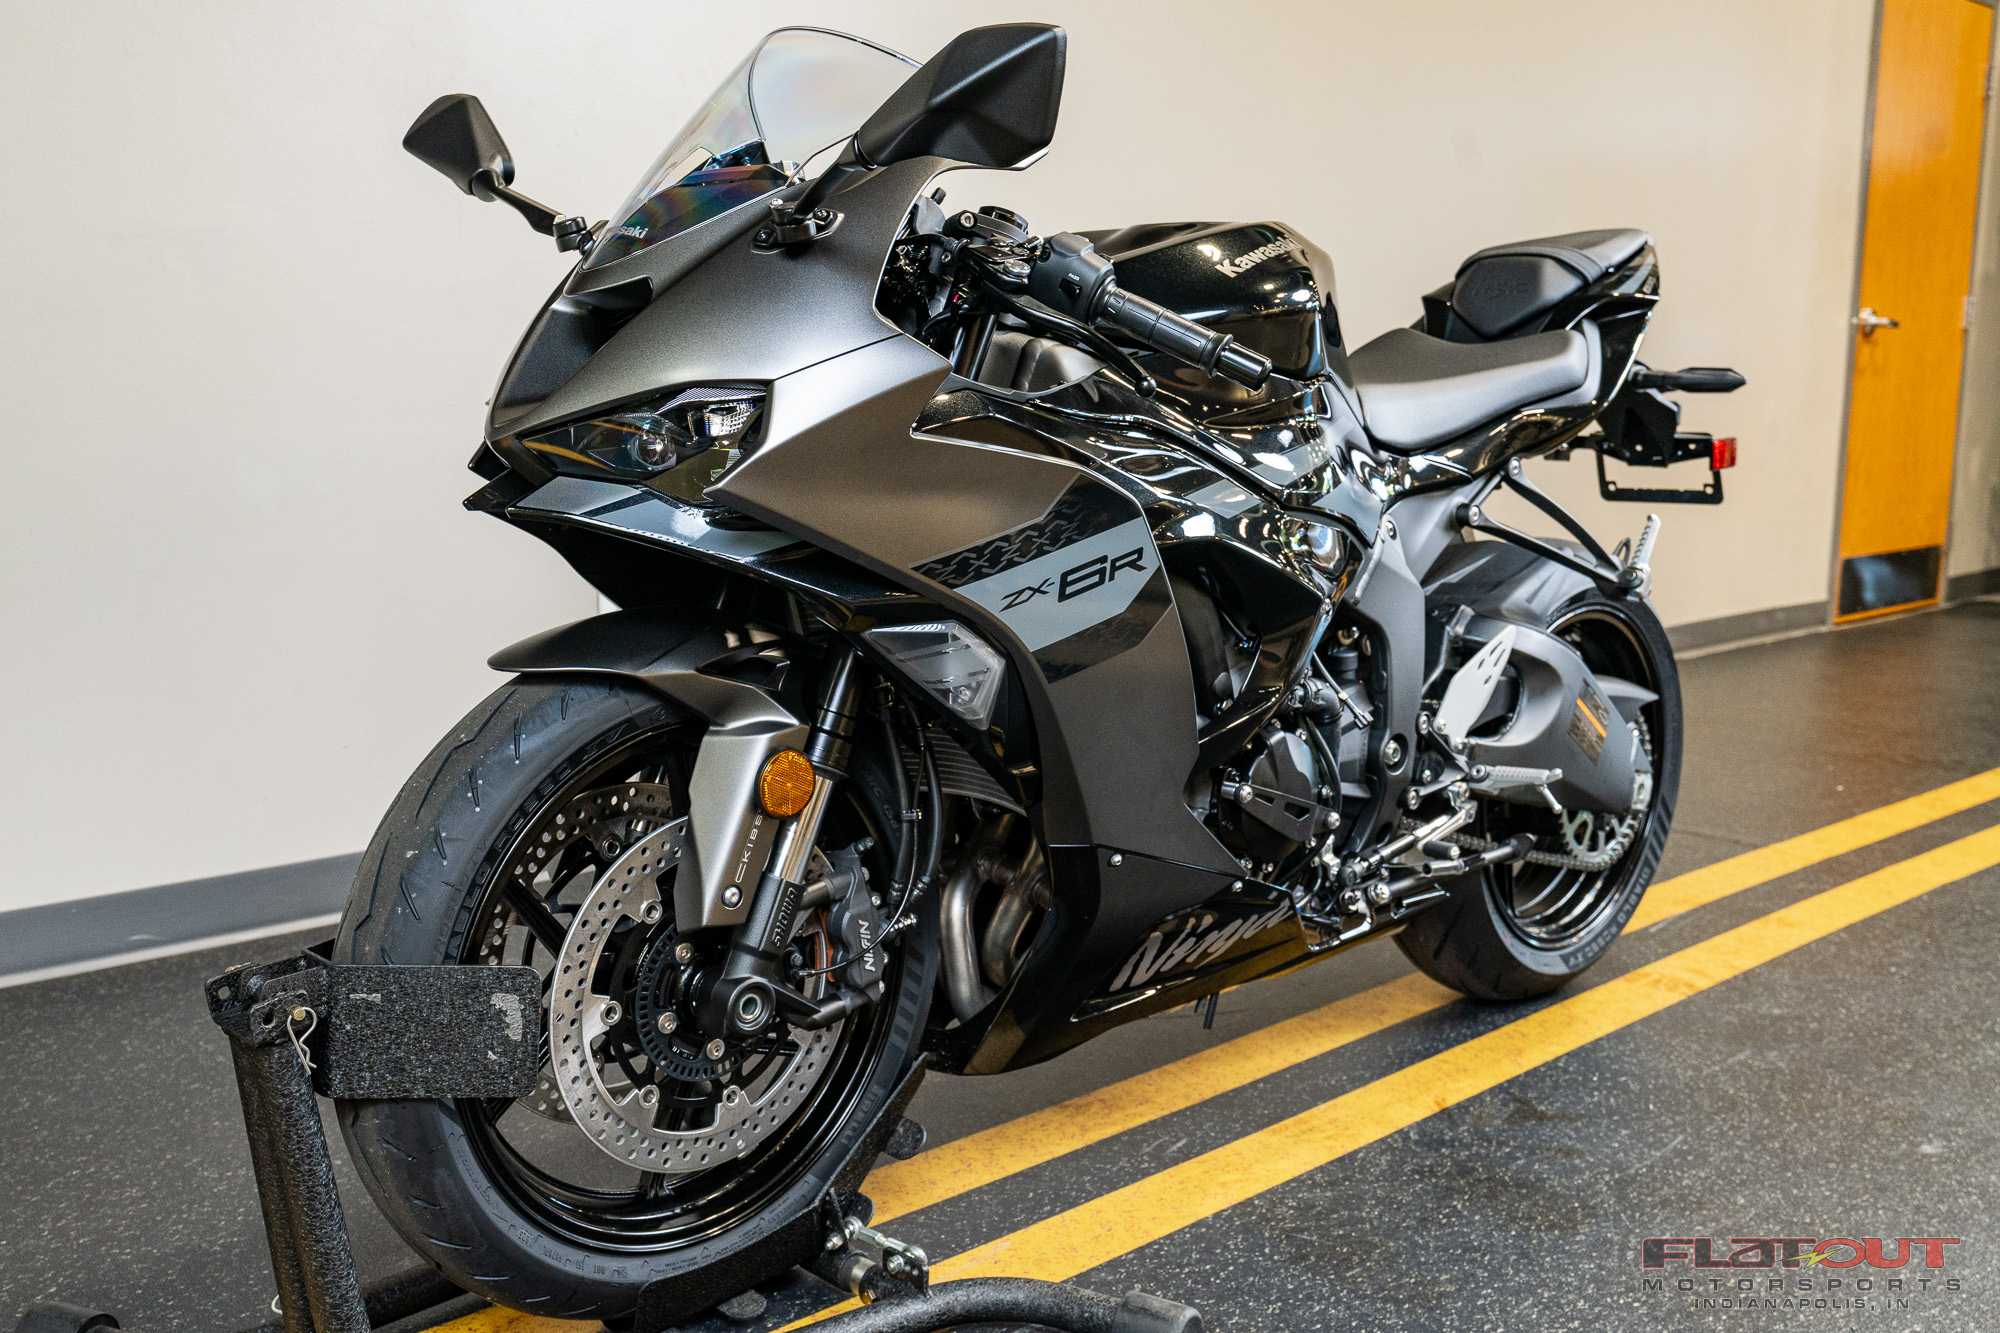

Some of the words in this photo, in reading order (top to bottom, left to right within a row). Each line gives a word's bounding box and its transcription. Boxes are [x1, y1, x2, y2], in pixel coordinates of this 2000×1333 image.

[1215, 234, 1303, 279] Kawasaki
[998, 546, 1147, 613] ZX-6R
[858, 919, 876, 972] NISIN
[1109, 891, 1293, 992] Ninja
